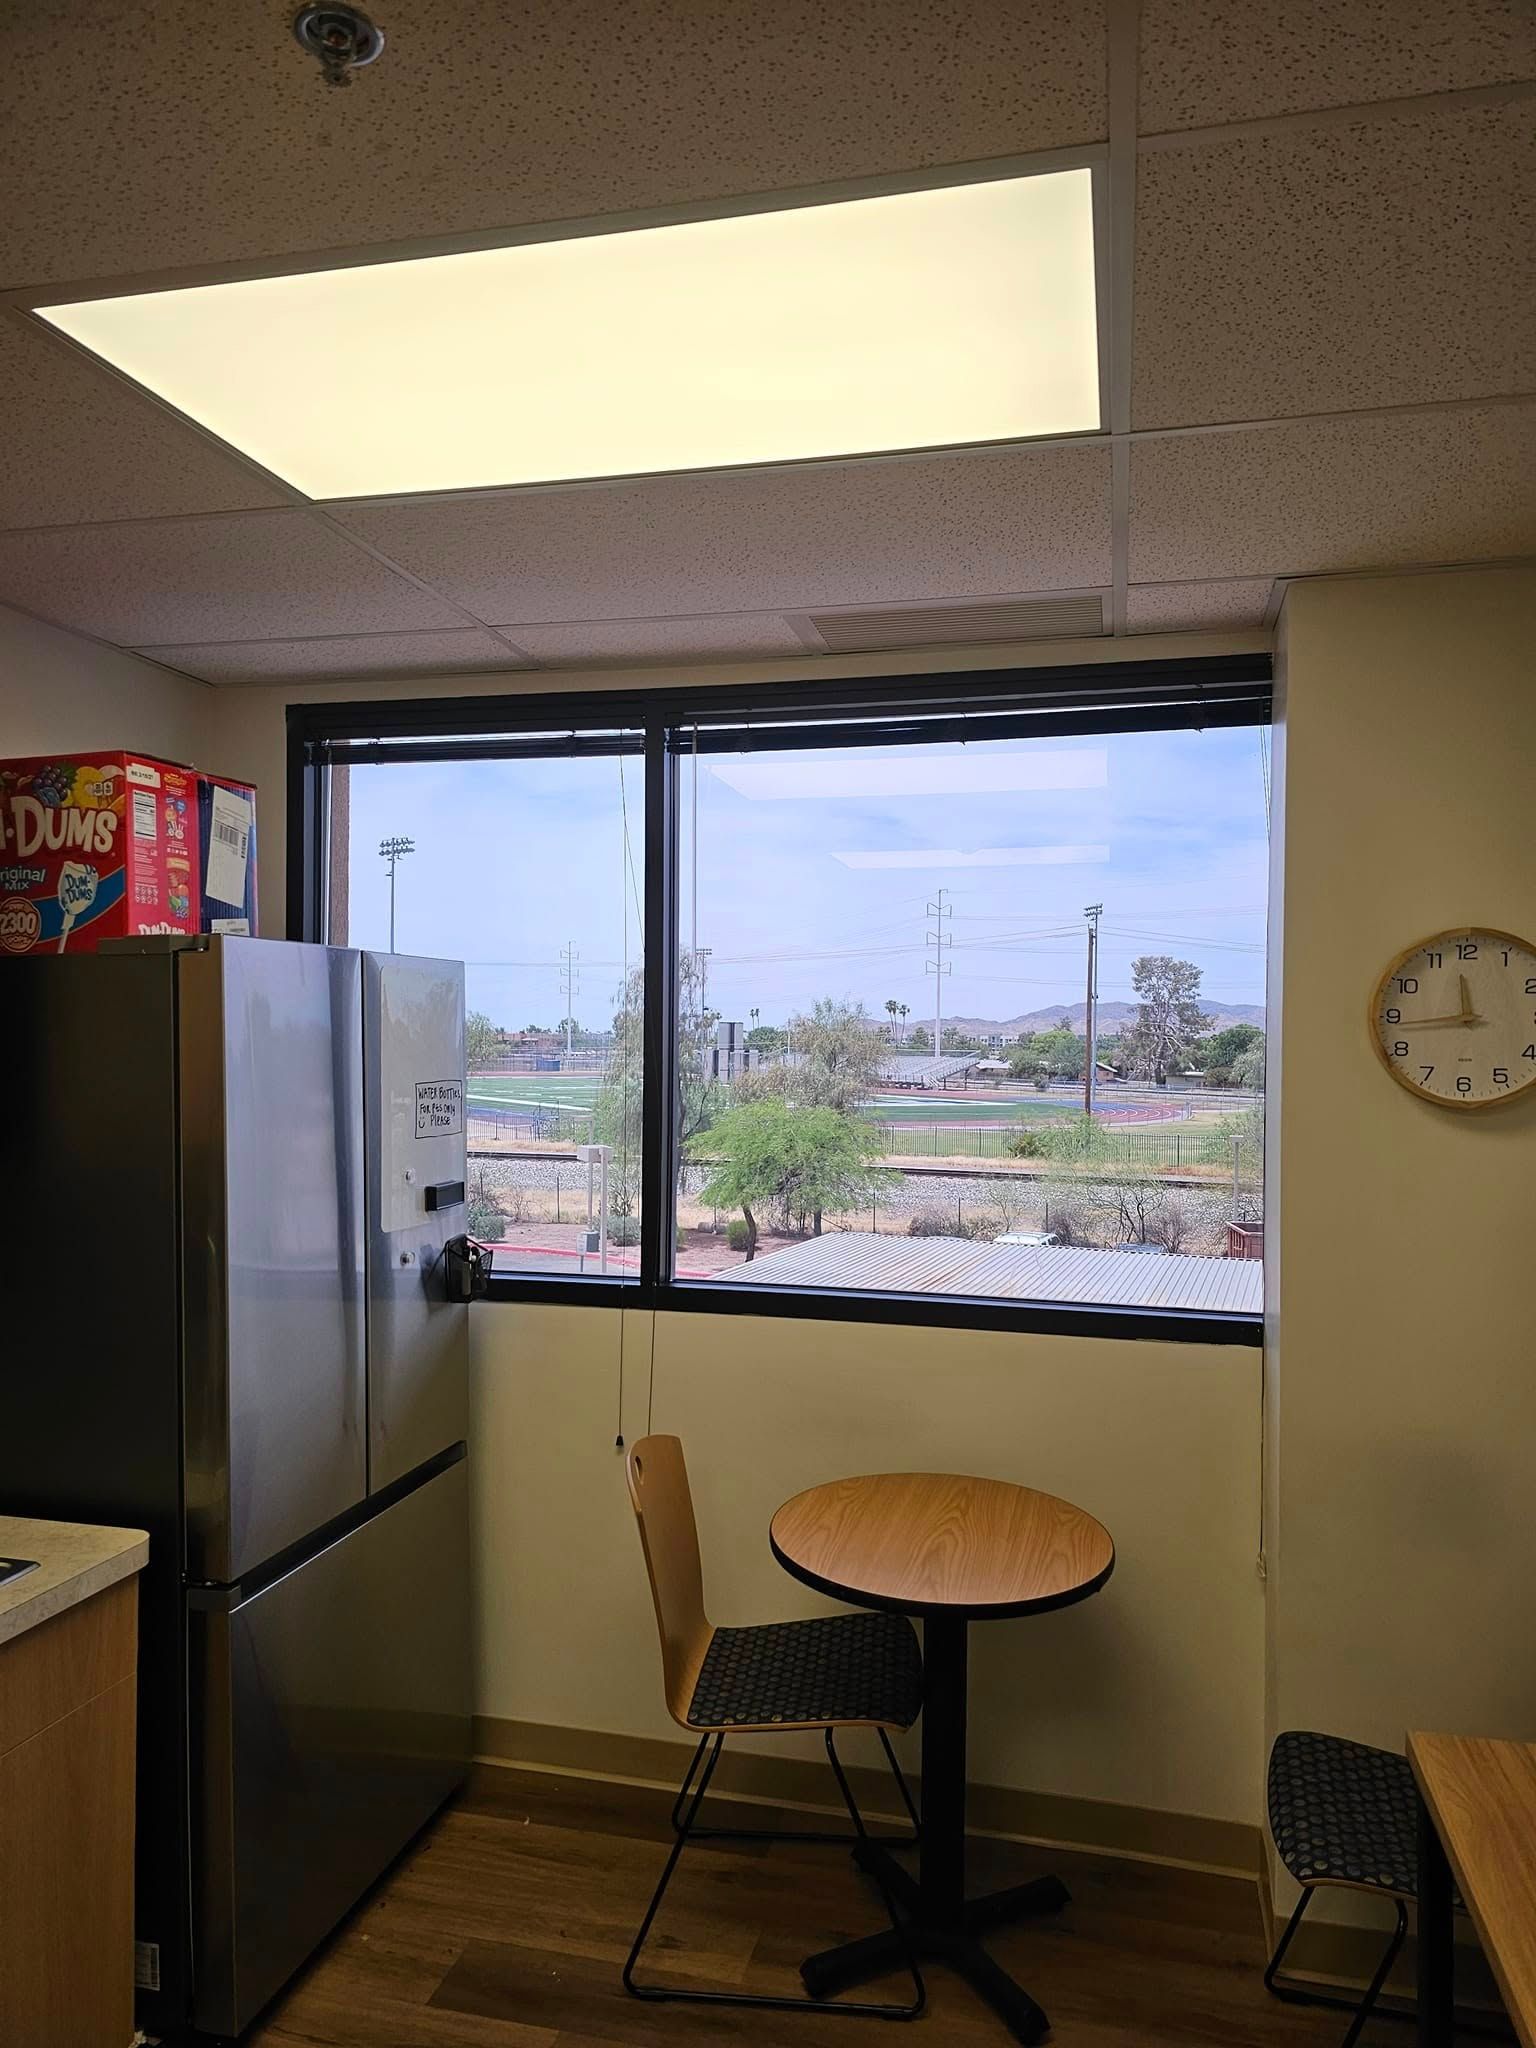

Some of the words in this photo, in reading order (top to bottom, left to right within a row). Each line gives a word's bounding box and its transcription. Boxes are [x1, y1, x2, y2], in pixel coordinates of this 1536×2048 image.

[0, 865, 46, 883] riginal
[65, 887, 93, 903] DUMS
[0, 911, 37, 935] 2300
[1456, 944, 1478, 960] 12
[1501, 951, 1508, 967] 1
[1427, 953, 1442, 968] 11
[1396, 978, 1418, 994] 10
[1525, 978, 1536, 994] 2
[1386, 1008, 1401, 1024] 9
[1394, 1041, 1409, 1056] 8
[1521, 1044, 1536, 1060] 4
[1419, 1066, 1435, 1081] 7
[1493, 1068, 1508, 1084] 5
[1456, 1077, 1471, 1092] 6
[418, 1086, 437, 1100] WATER
[420, 1103, 431, 1114] FOR
